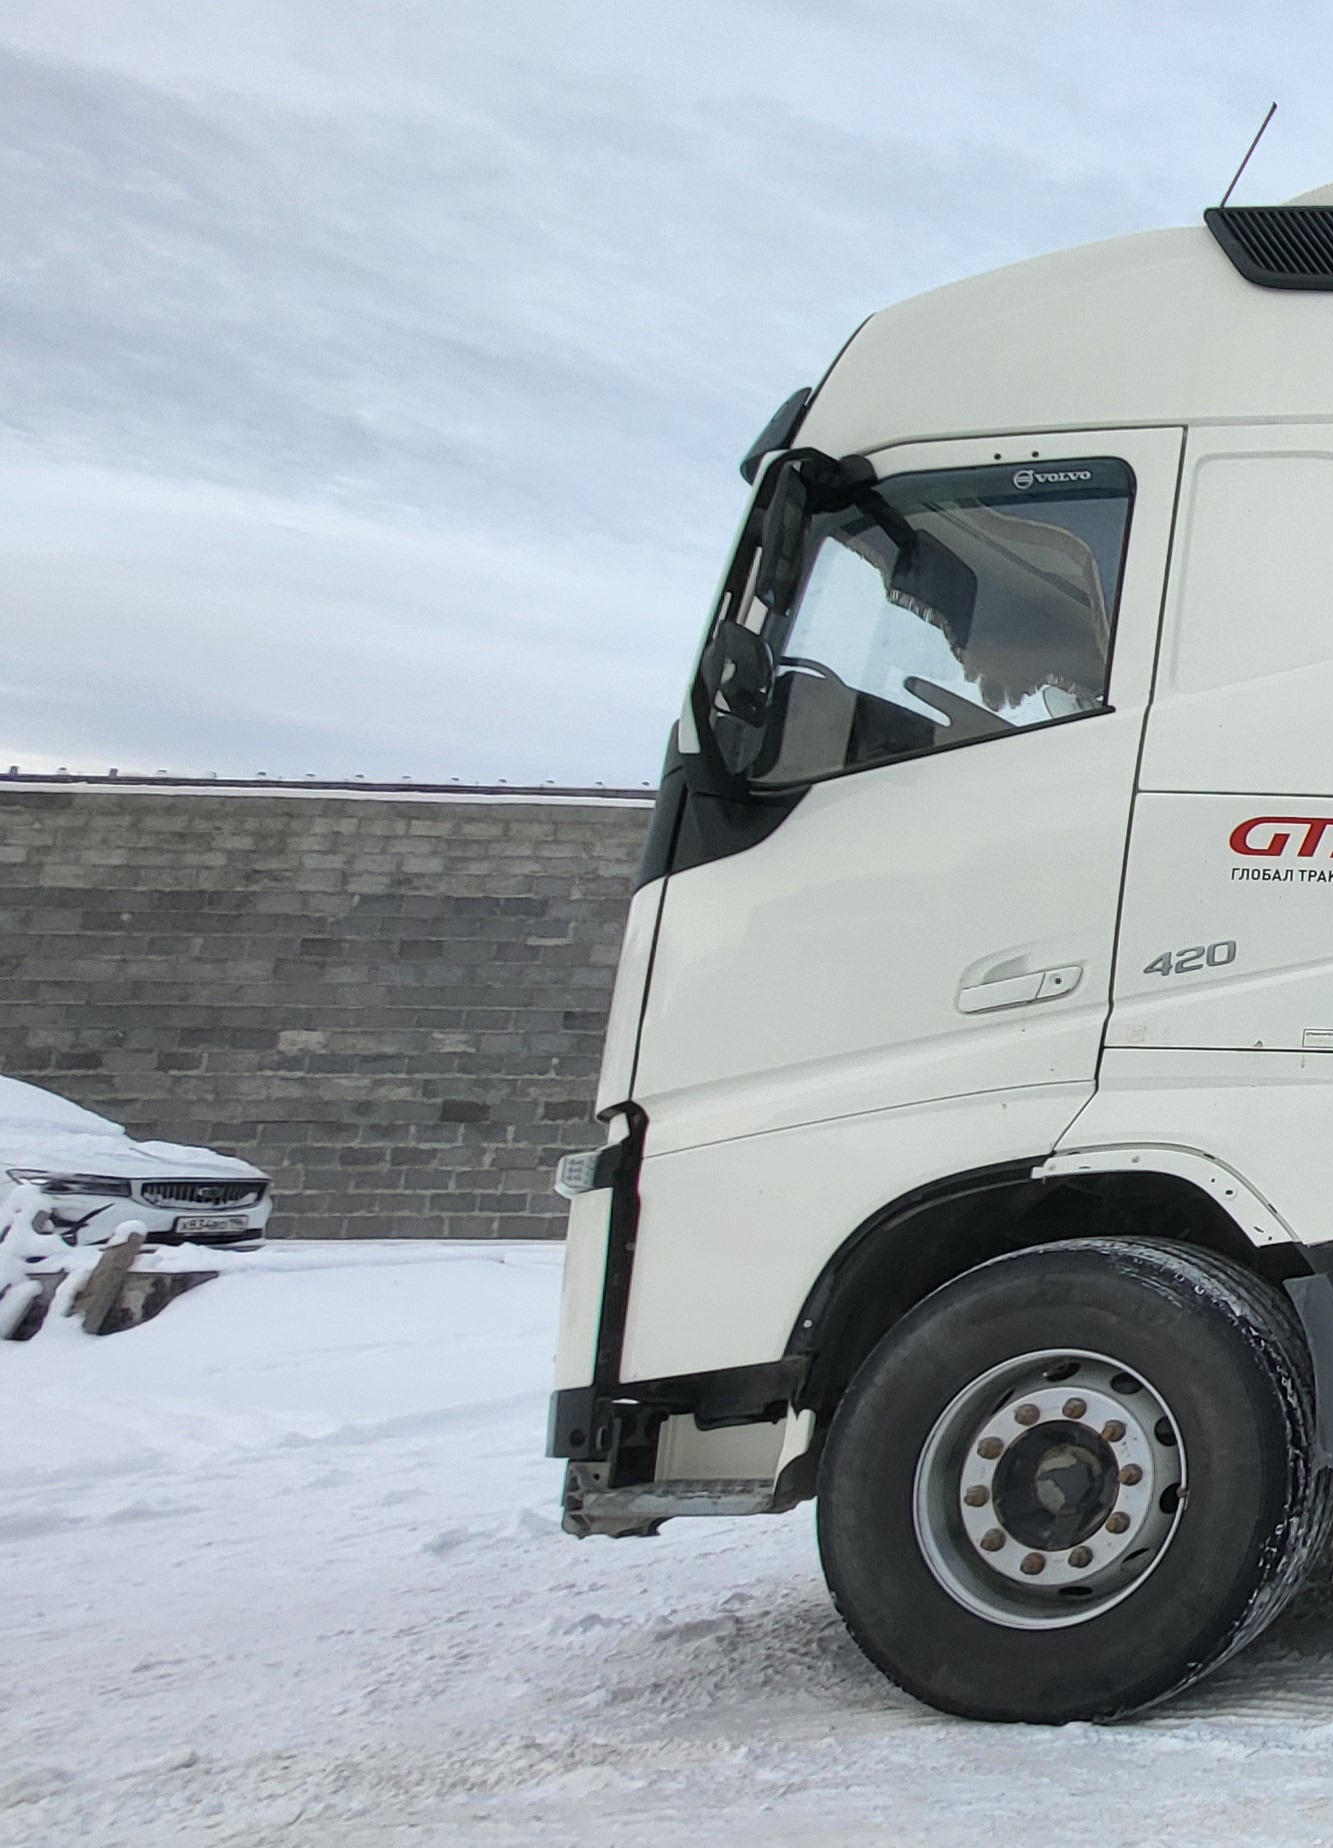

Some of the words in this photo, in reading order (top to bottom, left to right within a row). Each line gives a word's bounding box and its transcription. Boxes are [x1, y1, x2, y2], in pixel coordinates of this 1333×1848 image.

[1034, 470, 1092, 483] VOLVO
[1230, 867, 1295, 882] ГЛОБАЛ
[1143, 940, 1237, 976] 420
